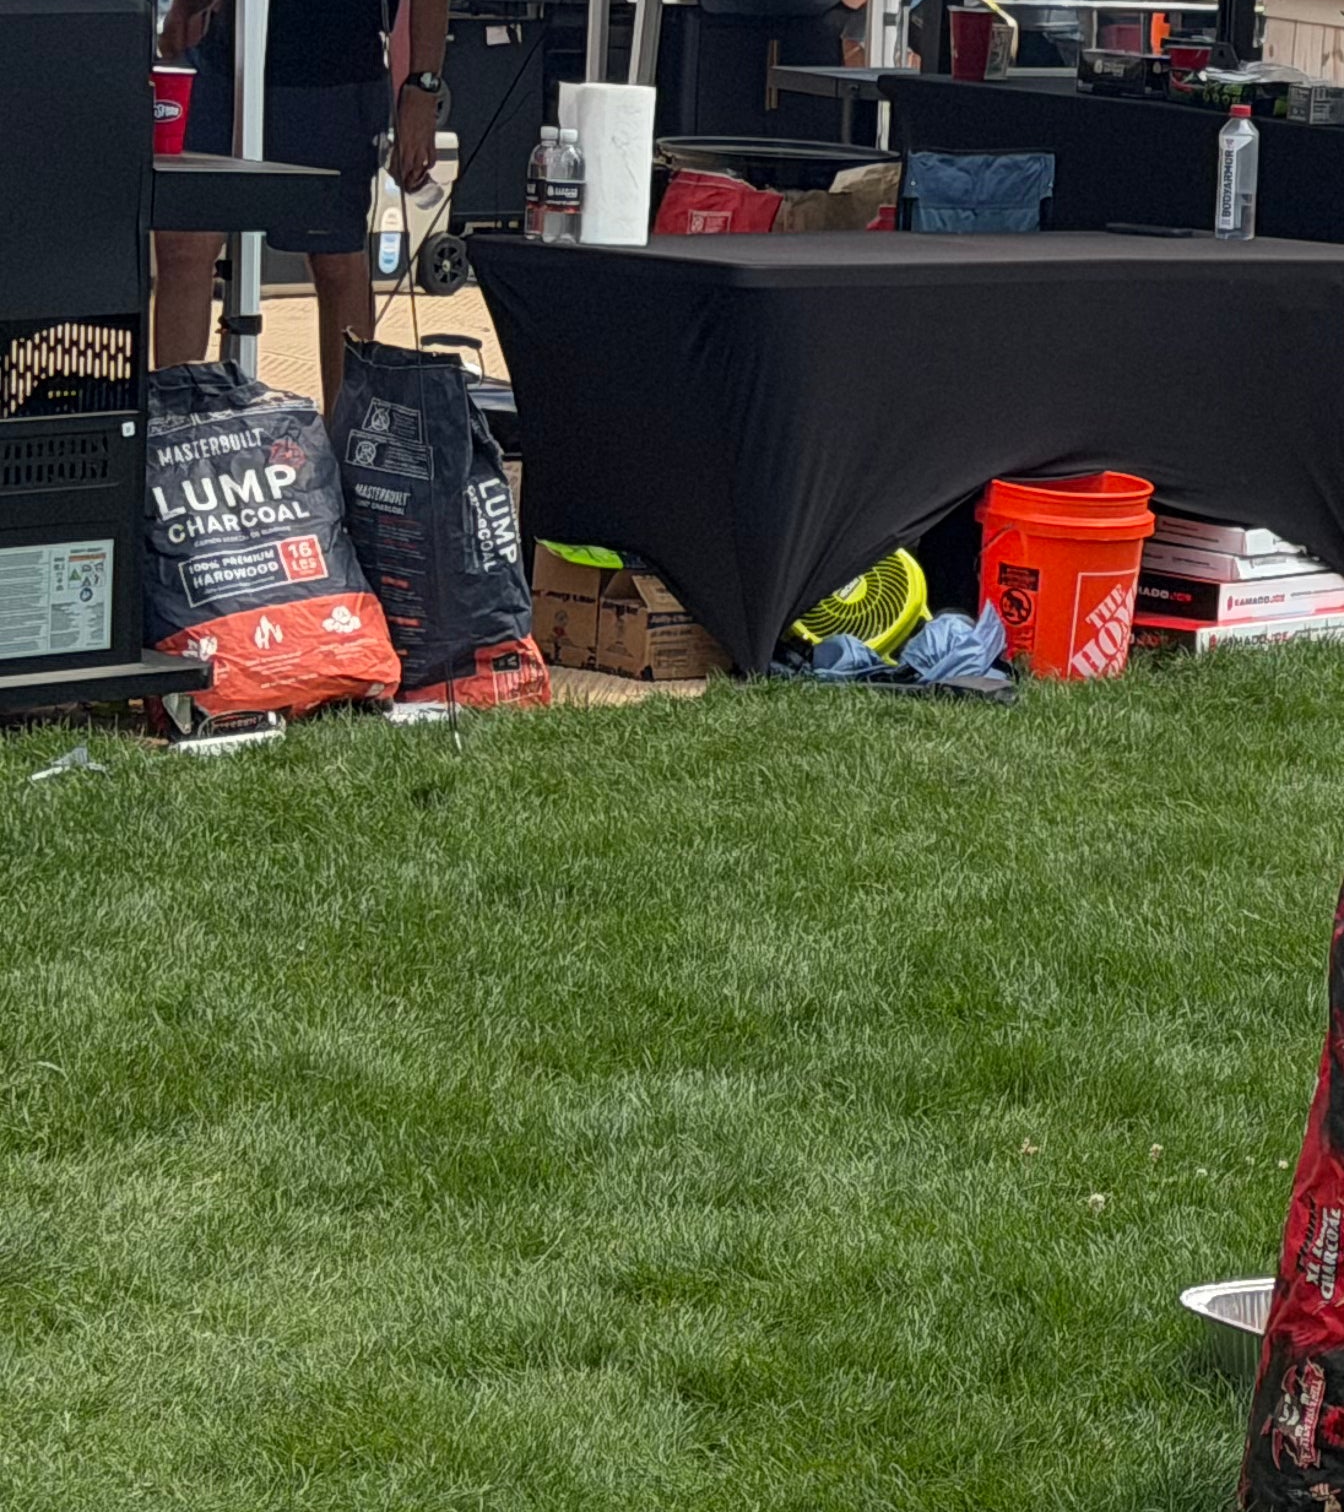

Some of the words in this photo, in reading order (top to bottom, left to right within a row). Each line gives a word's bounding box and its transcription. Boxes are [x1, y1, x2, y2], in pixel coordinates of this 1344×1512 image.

[1219, 150, 1235, 218] BODYARMOR
[157, 427, 265, 467] MASTERBUILT
[152, 464, 297, 522] LUMP
[168, 501, 311, 544] CHARCOAL
[478, 476, 519, 565] LUMP
[193, 560, 280, 589] HARDWOOD
[1085, 583, 1126, 629] THE
